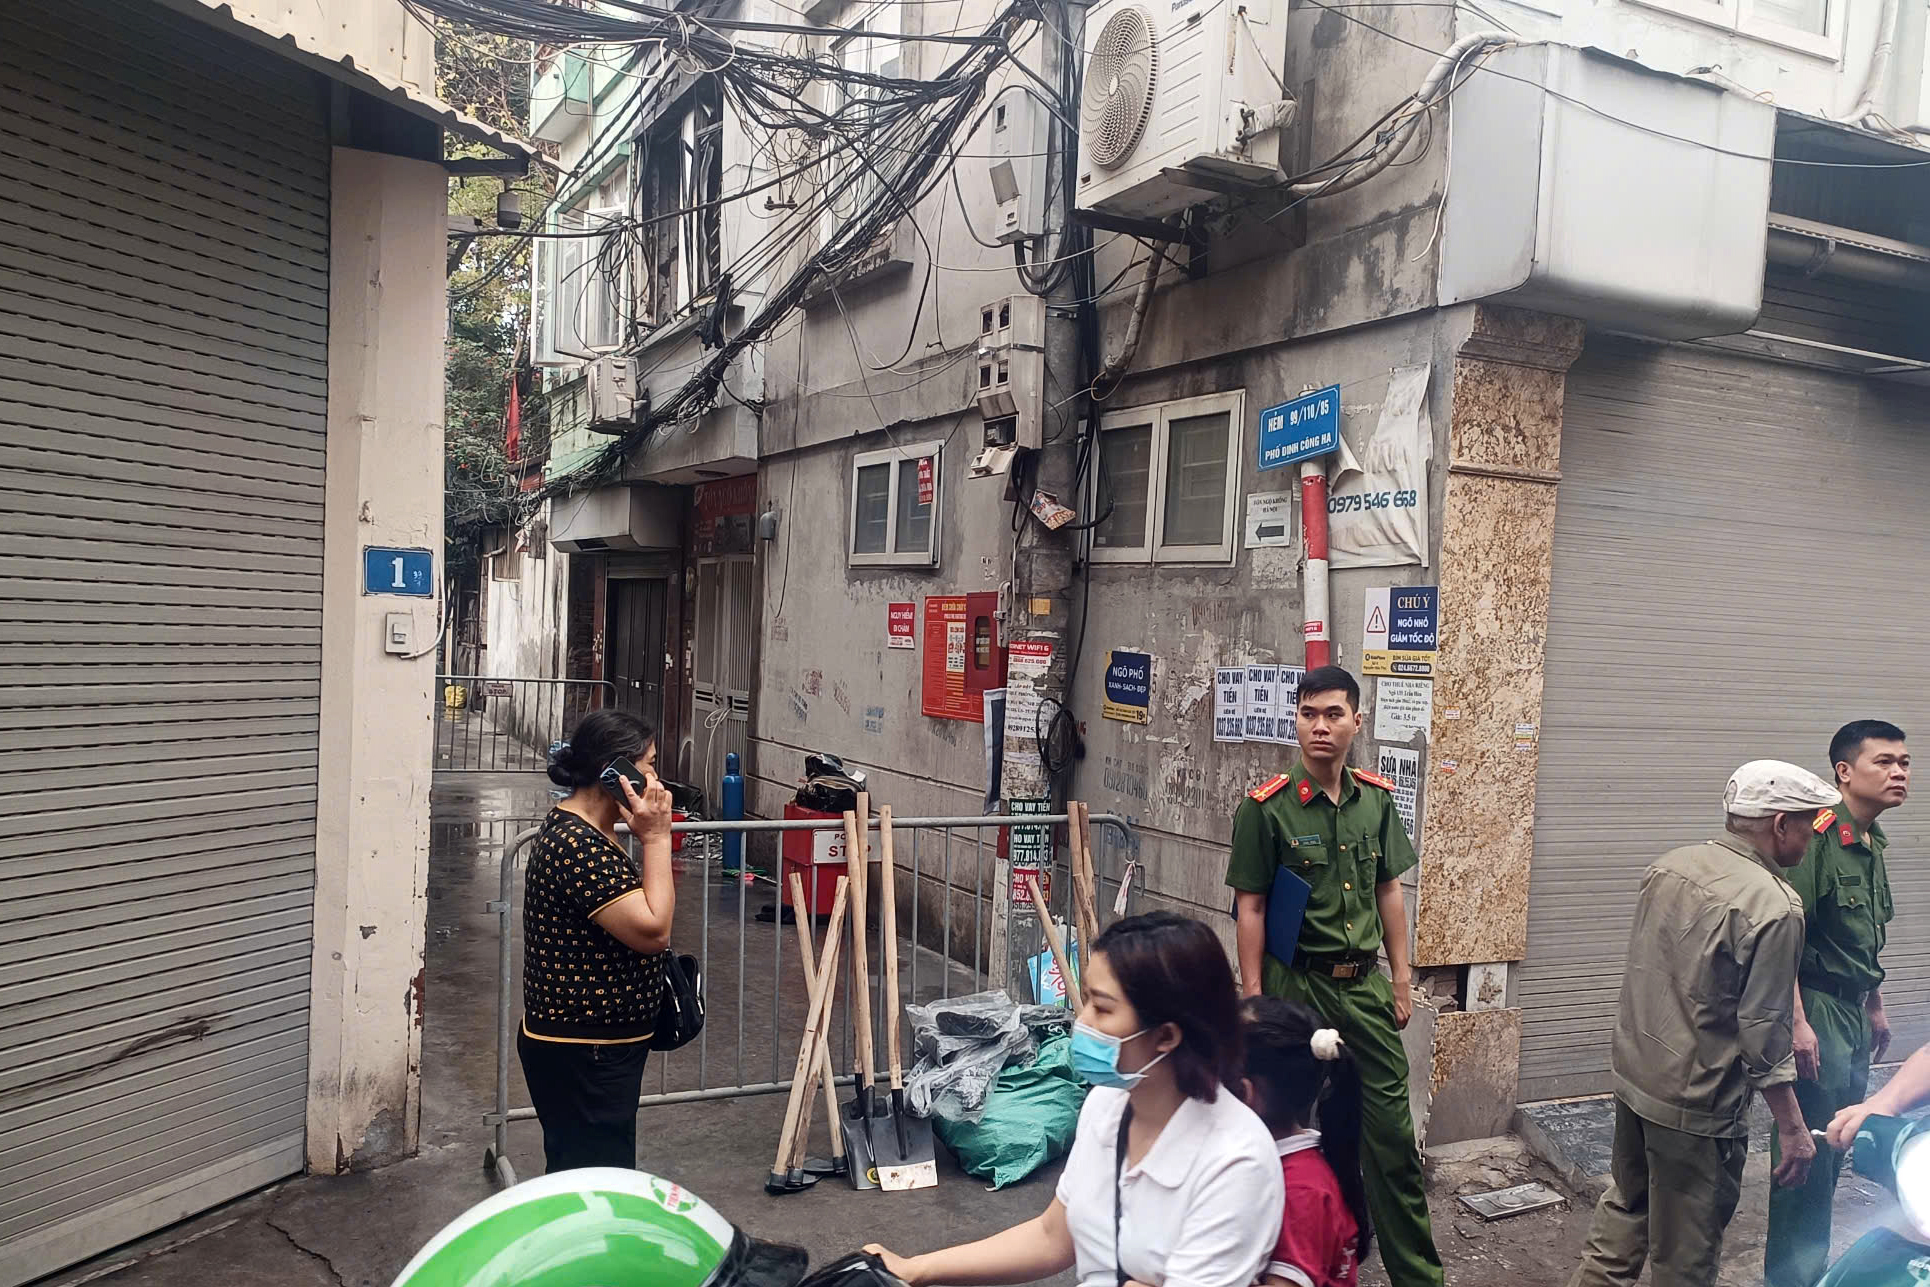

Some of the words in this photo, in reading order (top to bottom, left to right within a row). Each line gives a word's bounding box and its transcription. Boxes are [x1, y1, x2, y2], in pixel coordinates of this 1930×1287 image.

[1289, 399, 1329, 426] 99/110/85
[1300, 436, 1320, 451] CÔNG
[1321, 432, 1332, 447] HẠ
[1327, 494, 1362, 514] 0979
[1364, 491, 1392, 511] 546
[391, 557, 407, 588] 1
[1397, 593, 1421, 609] CHÚ
[1423, 593, 1432, 609] Ý
[1409, 631, 1423, 643] TỐC
[1424, 632, 1435, 646] ĐỘ
[1128, 665, 1144, 680] PHỐ
[1217, 672, 1231, 684] CHO
[1231, 671, 1243, 684] VAY
[1248, 669, 1262, 682] CHO
[1263, 669, 1276, 683] VAY
[1280, 671, 1295, 684] CHO
[1380, 750, 1397, 775] SỬA
[1011, 801, 1024, 811] CHO
[1024, 802, 1036, 811] VAY
[1023, 834, 1035, 844] VAY
